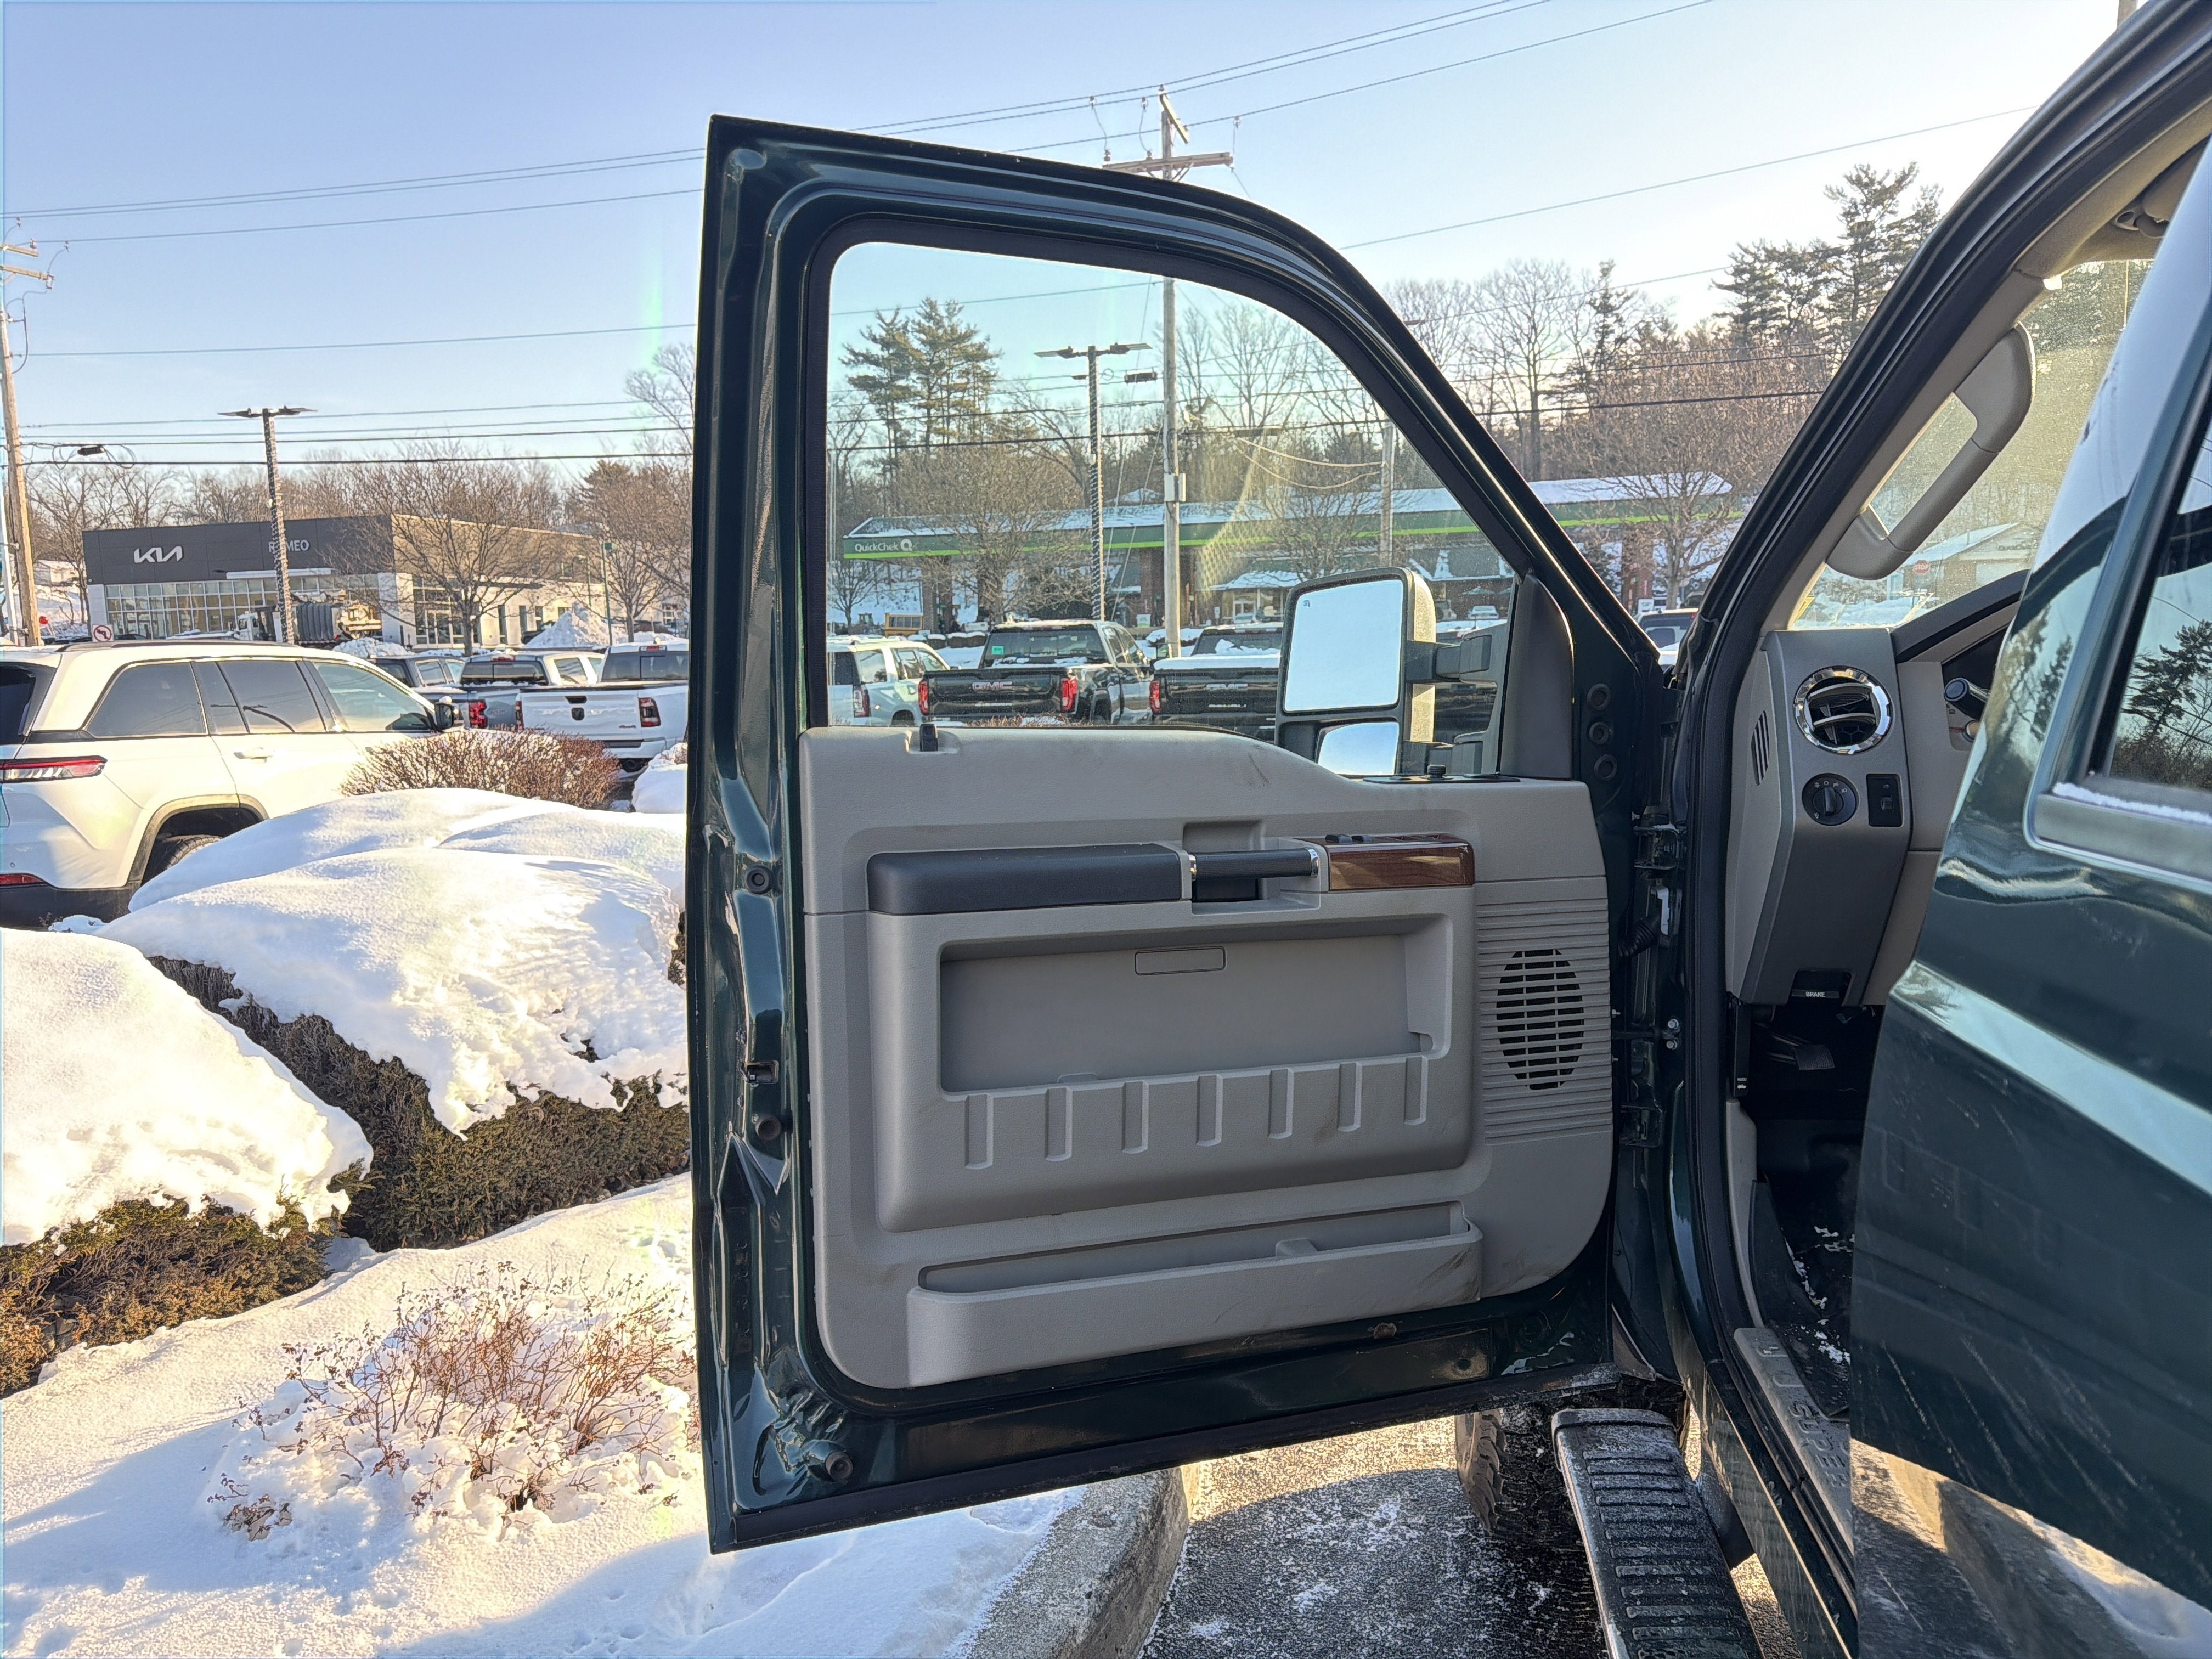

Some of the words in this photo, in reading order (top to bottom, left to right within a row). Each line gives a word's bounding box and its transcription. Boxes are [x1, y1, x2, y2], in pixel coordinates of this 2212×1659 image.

[268, 540, 309, 553] RMEO
[855, 542, 899, 552] QuickChek
[133, 546, 183, 563] KIA
[972, 681, 1013, 690] GMC
